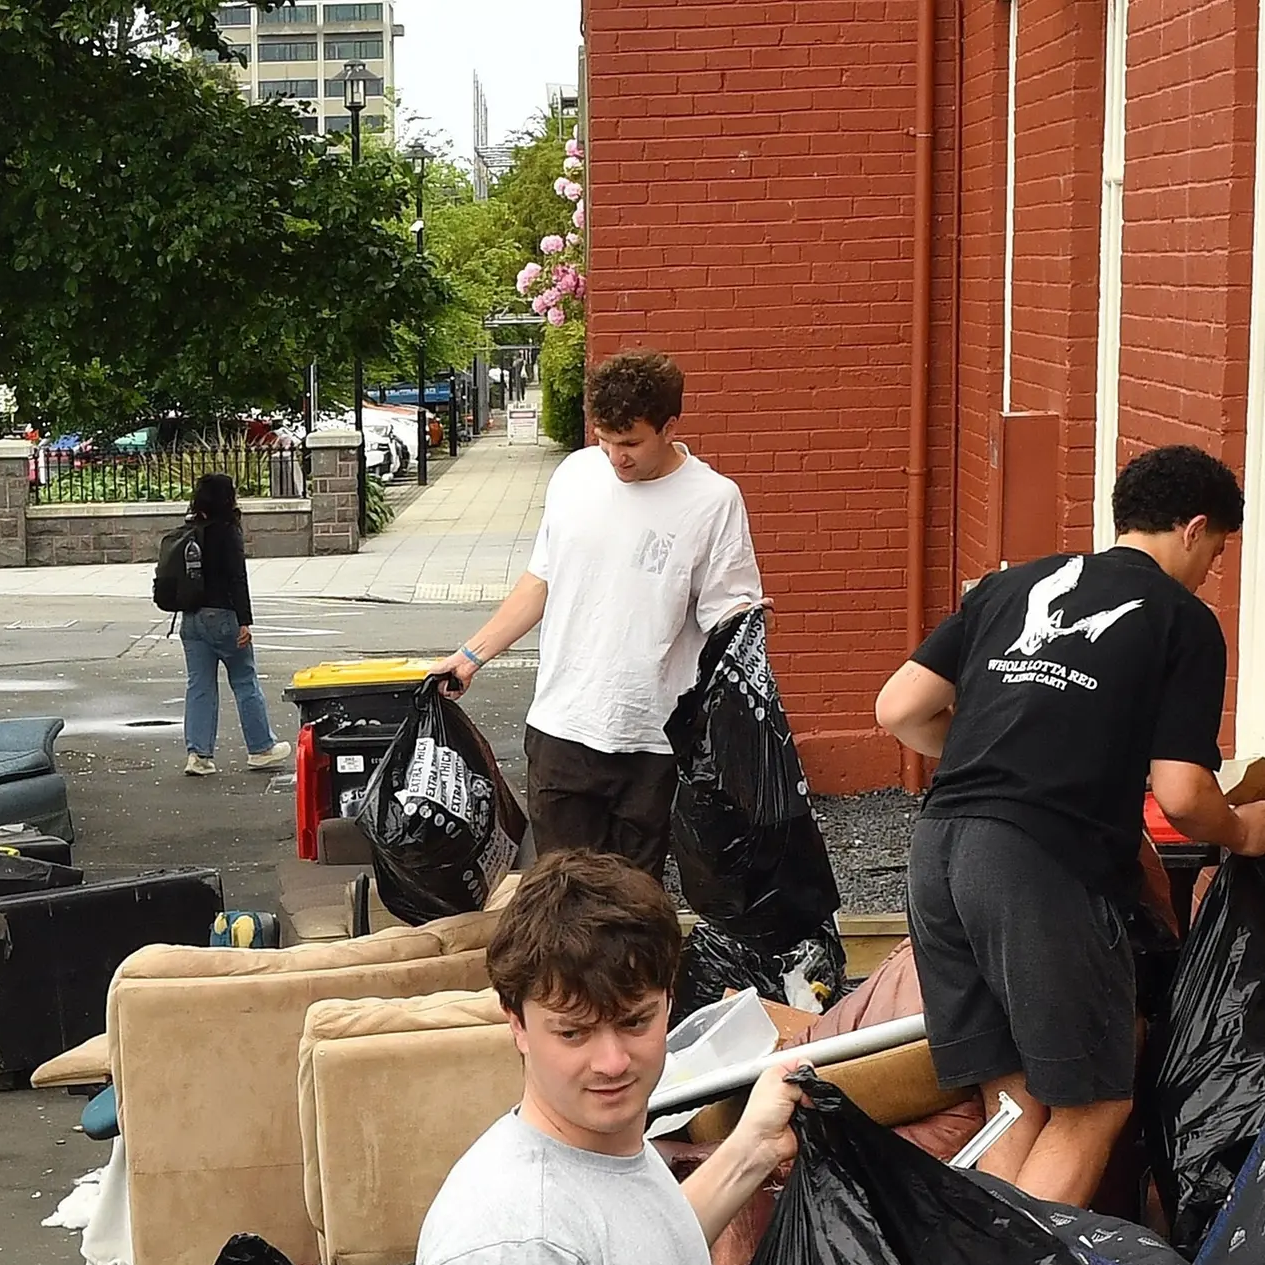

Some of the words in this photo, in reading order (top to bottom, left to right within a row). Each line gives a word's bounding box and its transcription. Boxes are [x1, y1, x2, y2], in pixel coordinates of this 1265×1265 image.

[987, 659, 1028, 672] WHOLE
[1026, 659, 1068, 679] LOTTA
[1067, 669, 1098, 690] RED
[1035, 673, 1068, 691] CARTI
[415, 740, 428, 764] THICK
[439, 750, 452, 777] THICK
[410, 766, 424, 793] EXTRA
[425, 769, 438, 798] EXTRA
[450, 784, 463, 813] EXTRA
